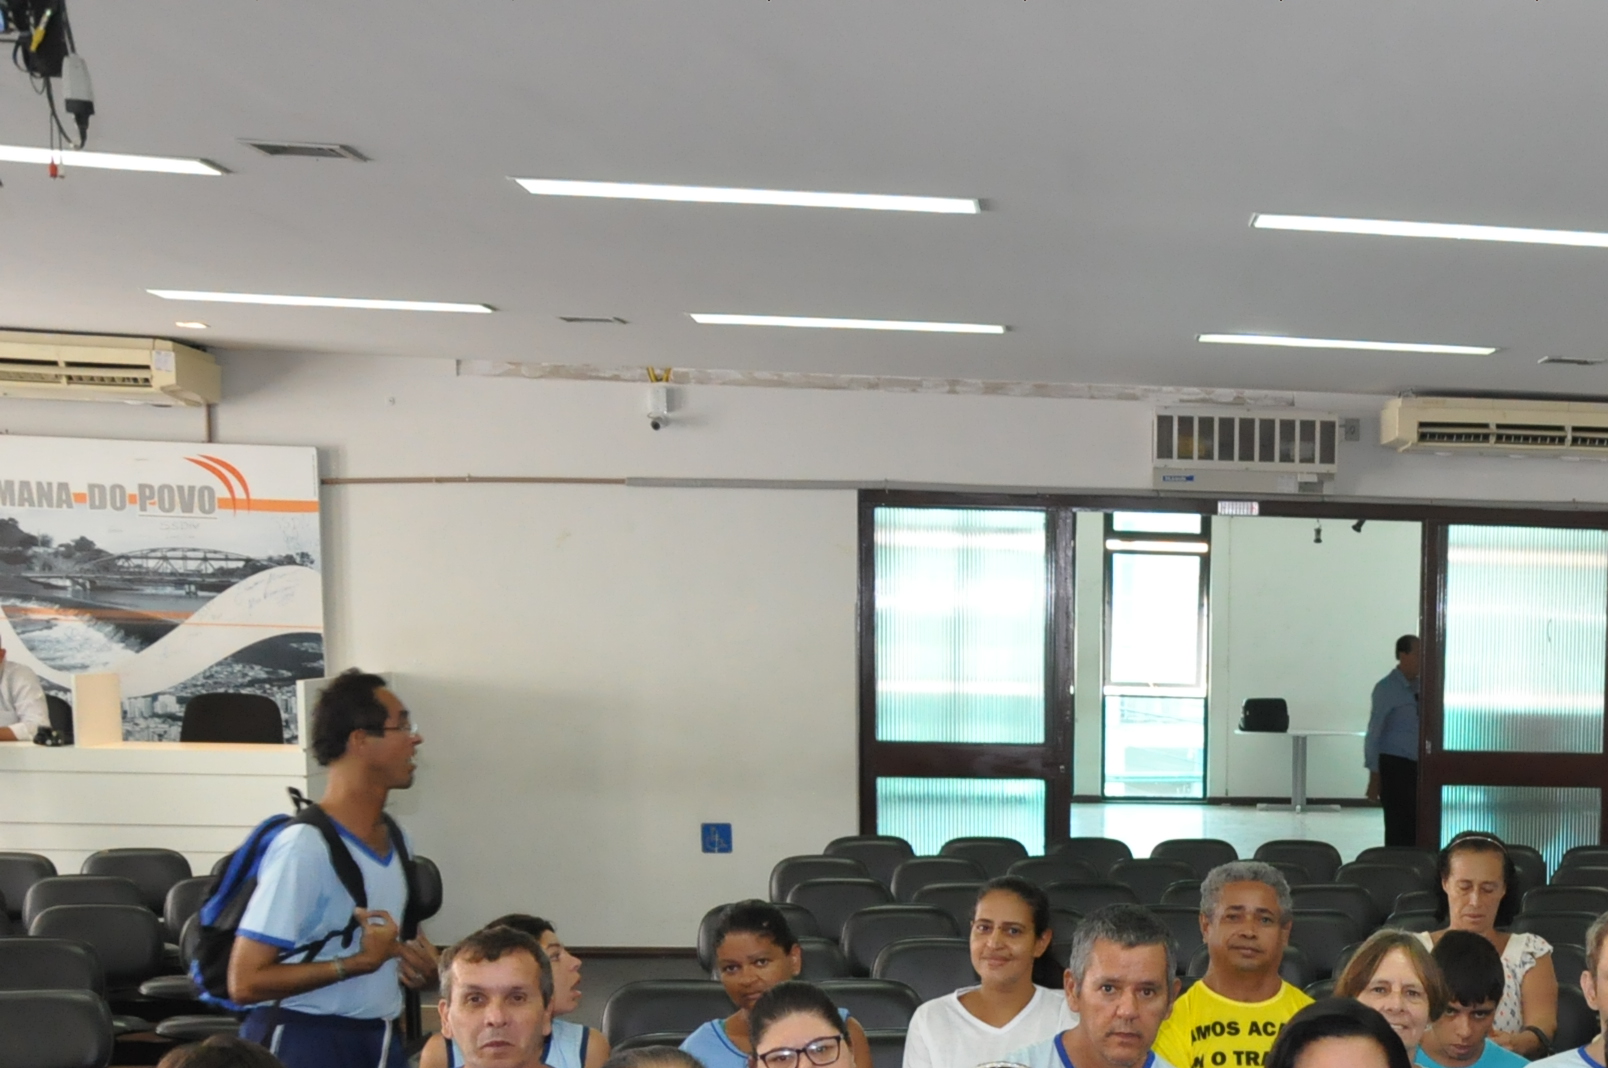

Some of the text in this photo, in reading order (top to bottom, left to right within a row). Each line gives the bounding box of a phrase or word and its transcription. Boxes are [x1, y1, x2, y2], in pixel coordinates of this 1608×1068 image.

[88, 483, 127, 511] DO
[138, 483, 216, 515] POVO
[1211, 1051, 1227, 1066] O
